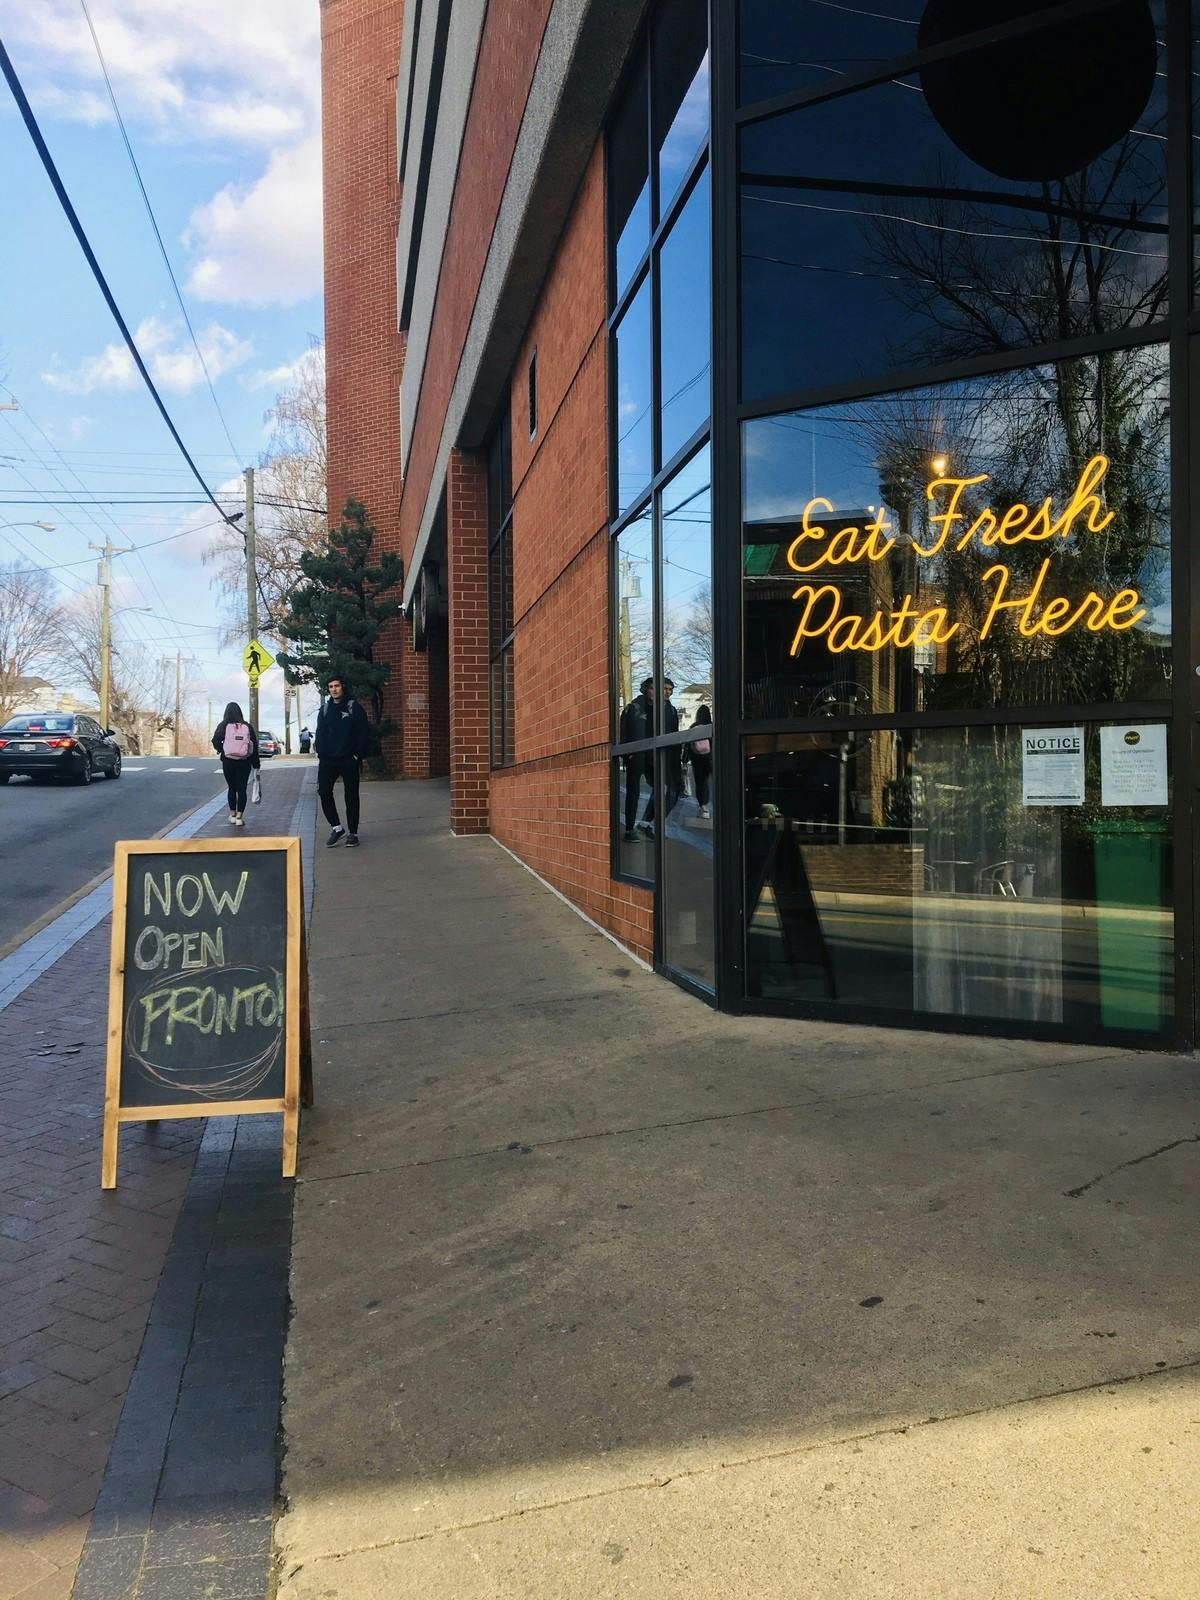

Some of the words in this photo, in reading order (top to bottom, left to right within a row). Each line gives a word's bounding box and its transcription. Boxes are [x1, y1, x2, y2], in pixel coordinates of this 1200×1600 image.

[787, 497, 897, 572] Eat
[911, 455, 1115, 557] Fresh
[790, 585, 960, 656] Pasta
[980, 558, 1146, 641] Here
[1026, 737, 1081, 750] NOTICE
[144, 871, 248, 917] NOW
[134, 925, 225, 970] OPEN
[139, 973, 285, 1052] PRONTO!
